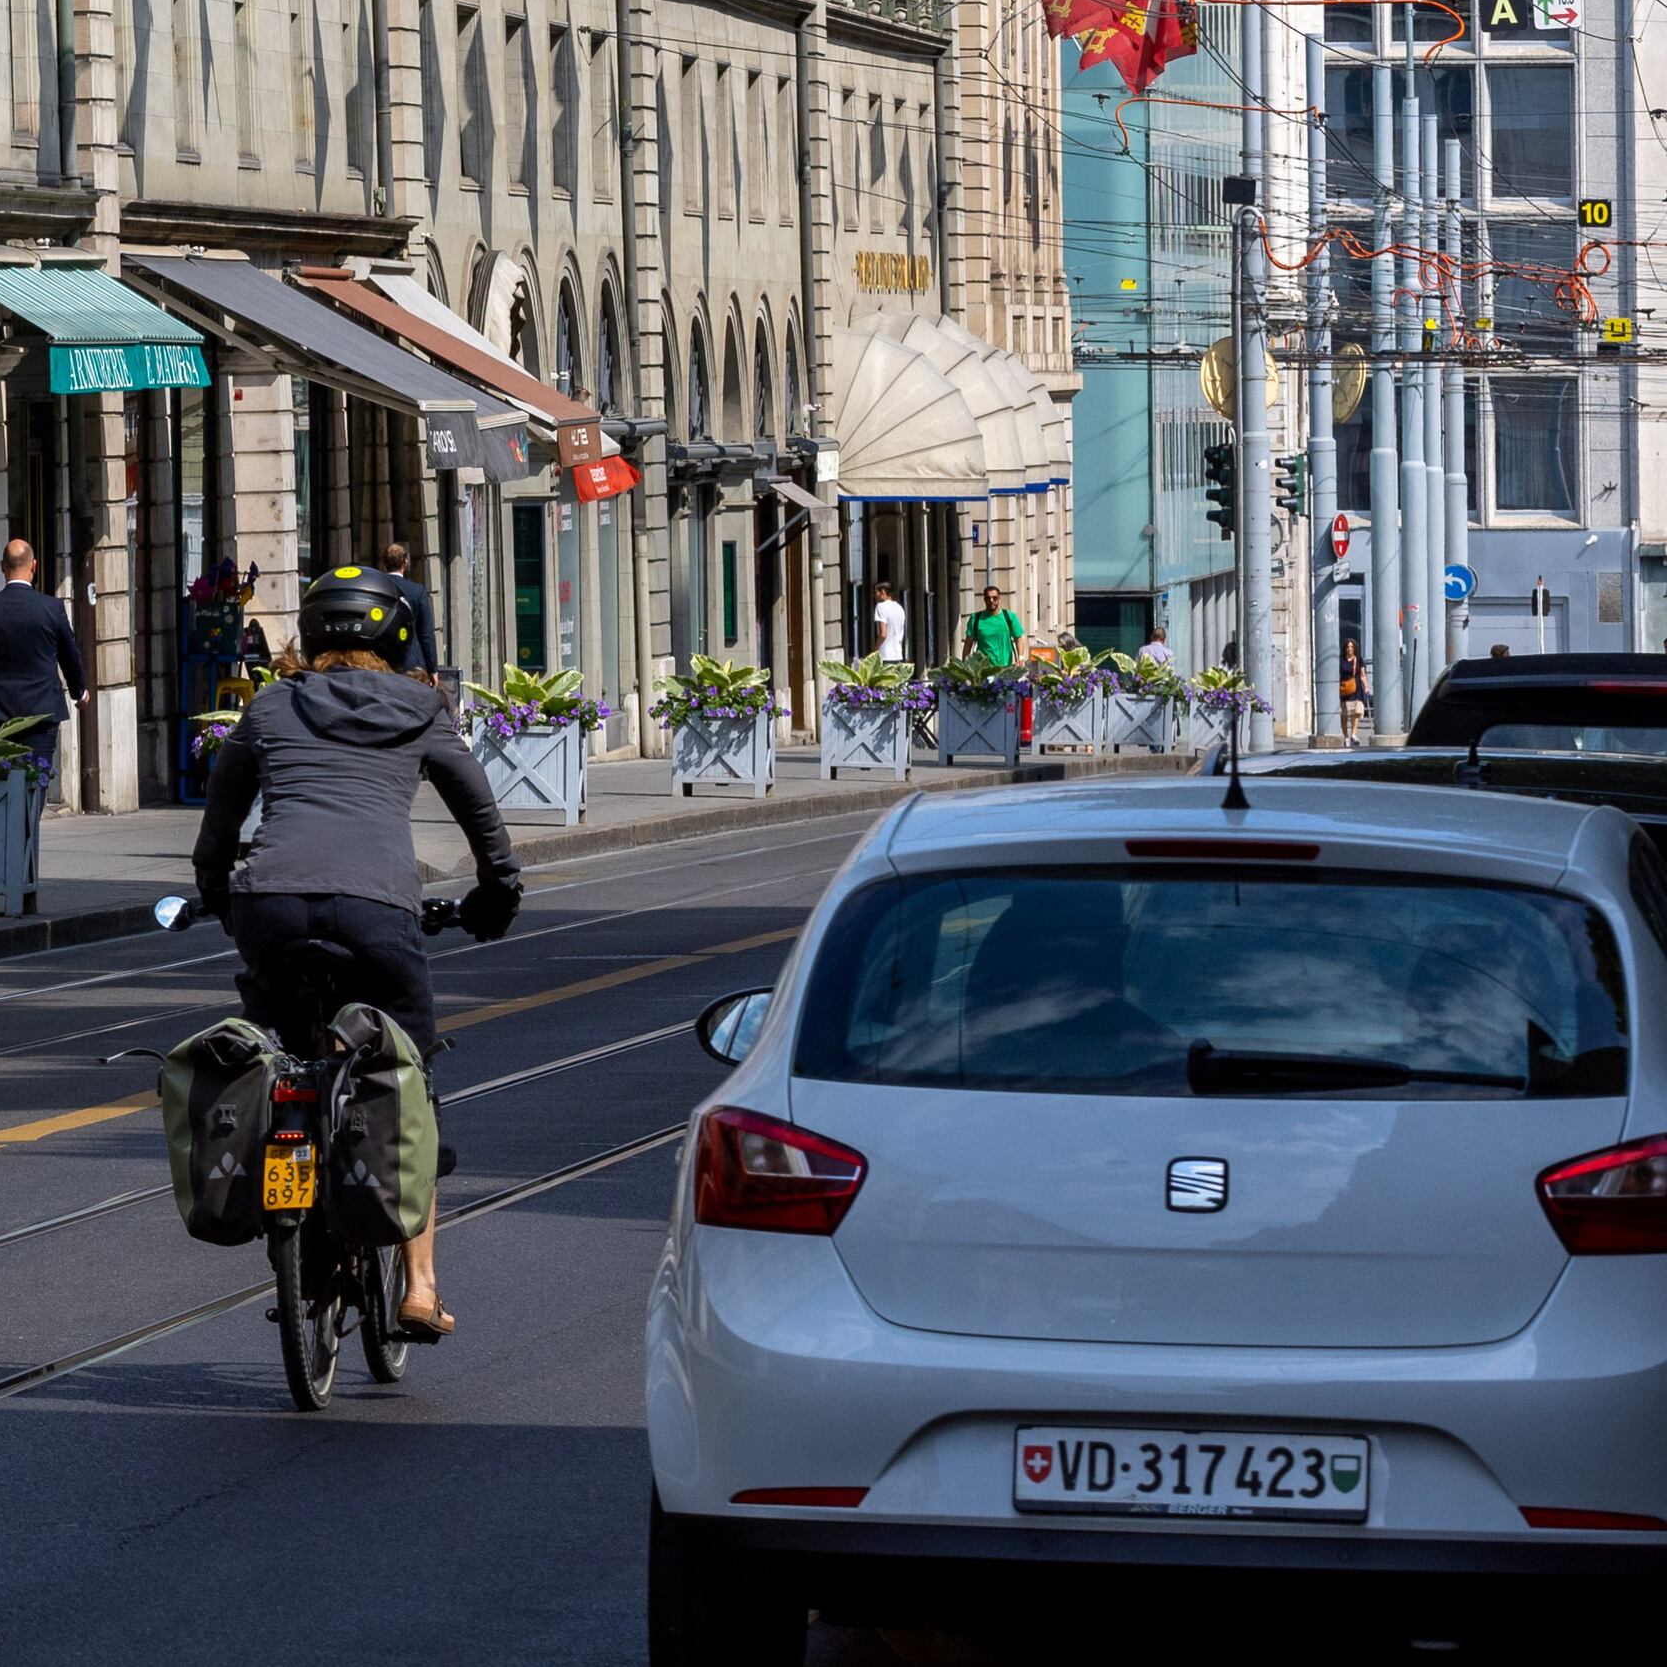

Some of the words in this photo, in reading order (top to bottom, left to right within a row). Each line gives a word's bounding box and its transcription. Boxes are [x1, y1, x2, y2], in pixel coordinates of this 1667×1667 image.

[1581, 202, 1609, 225] 10
[69, 348, 134, 391] ARMURERIE
[268, 1165, 310, 1183] 635
[267, 1187, 310, 1205] 897
[1167, 1503, 1227, 1516] BERGER
